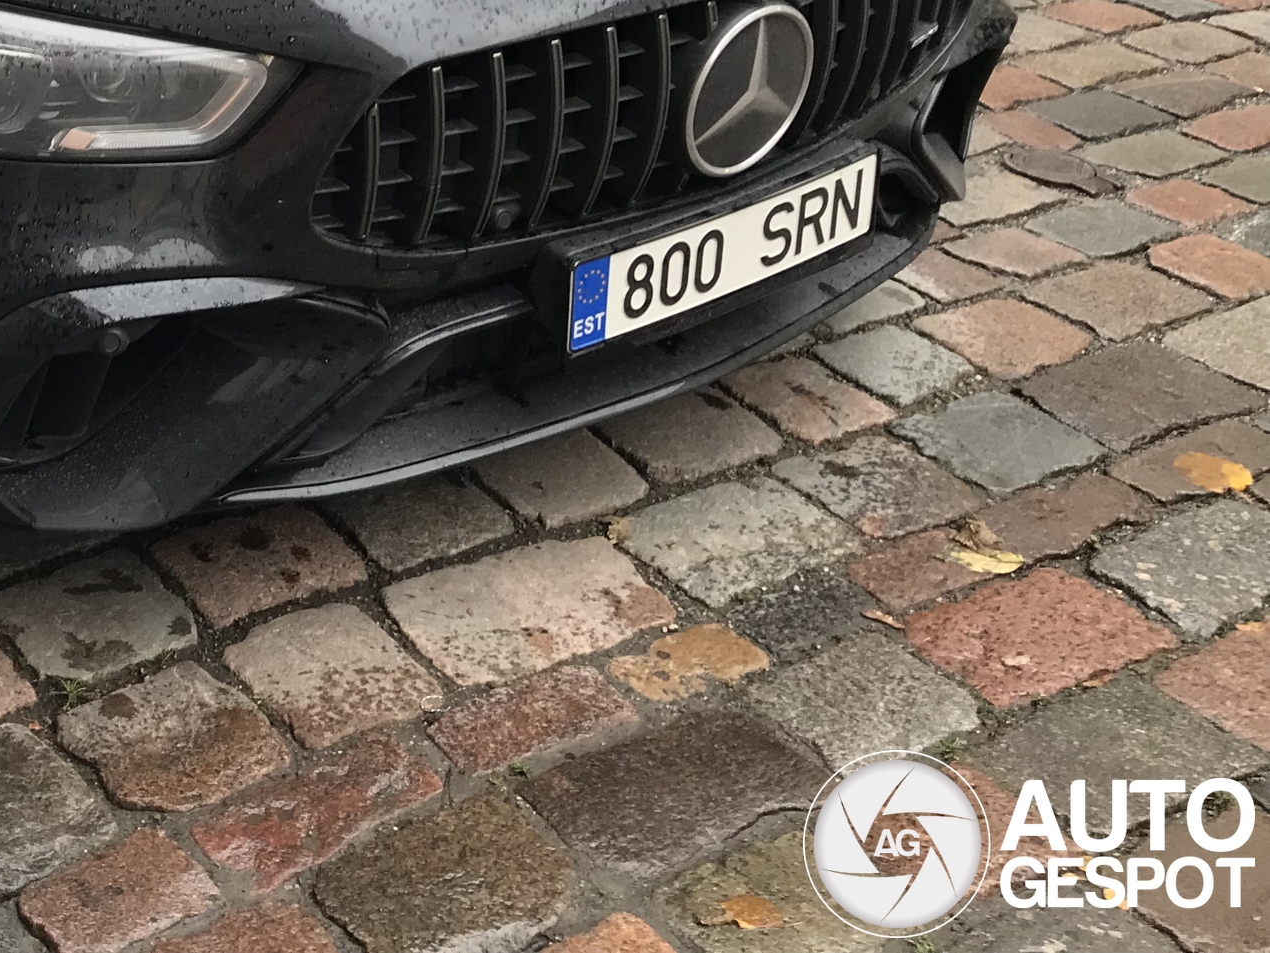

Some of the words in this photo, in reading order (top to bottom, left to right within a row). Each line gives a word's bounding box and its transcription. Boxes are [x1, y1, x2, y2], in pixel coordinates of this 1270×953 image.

[623, 229, 724, 318] 800
[760, 168, 864, 267] SRN
[572, 311, 606, 340] EST
